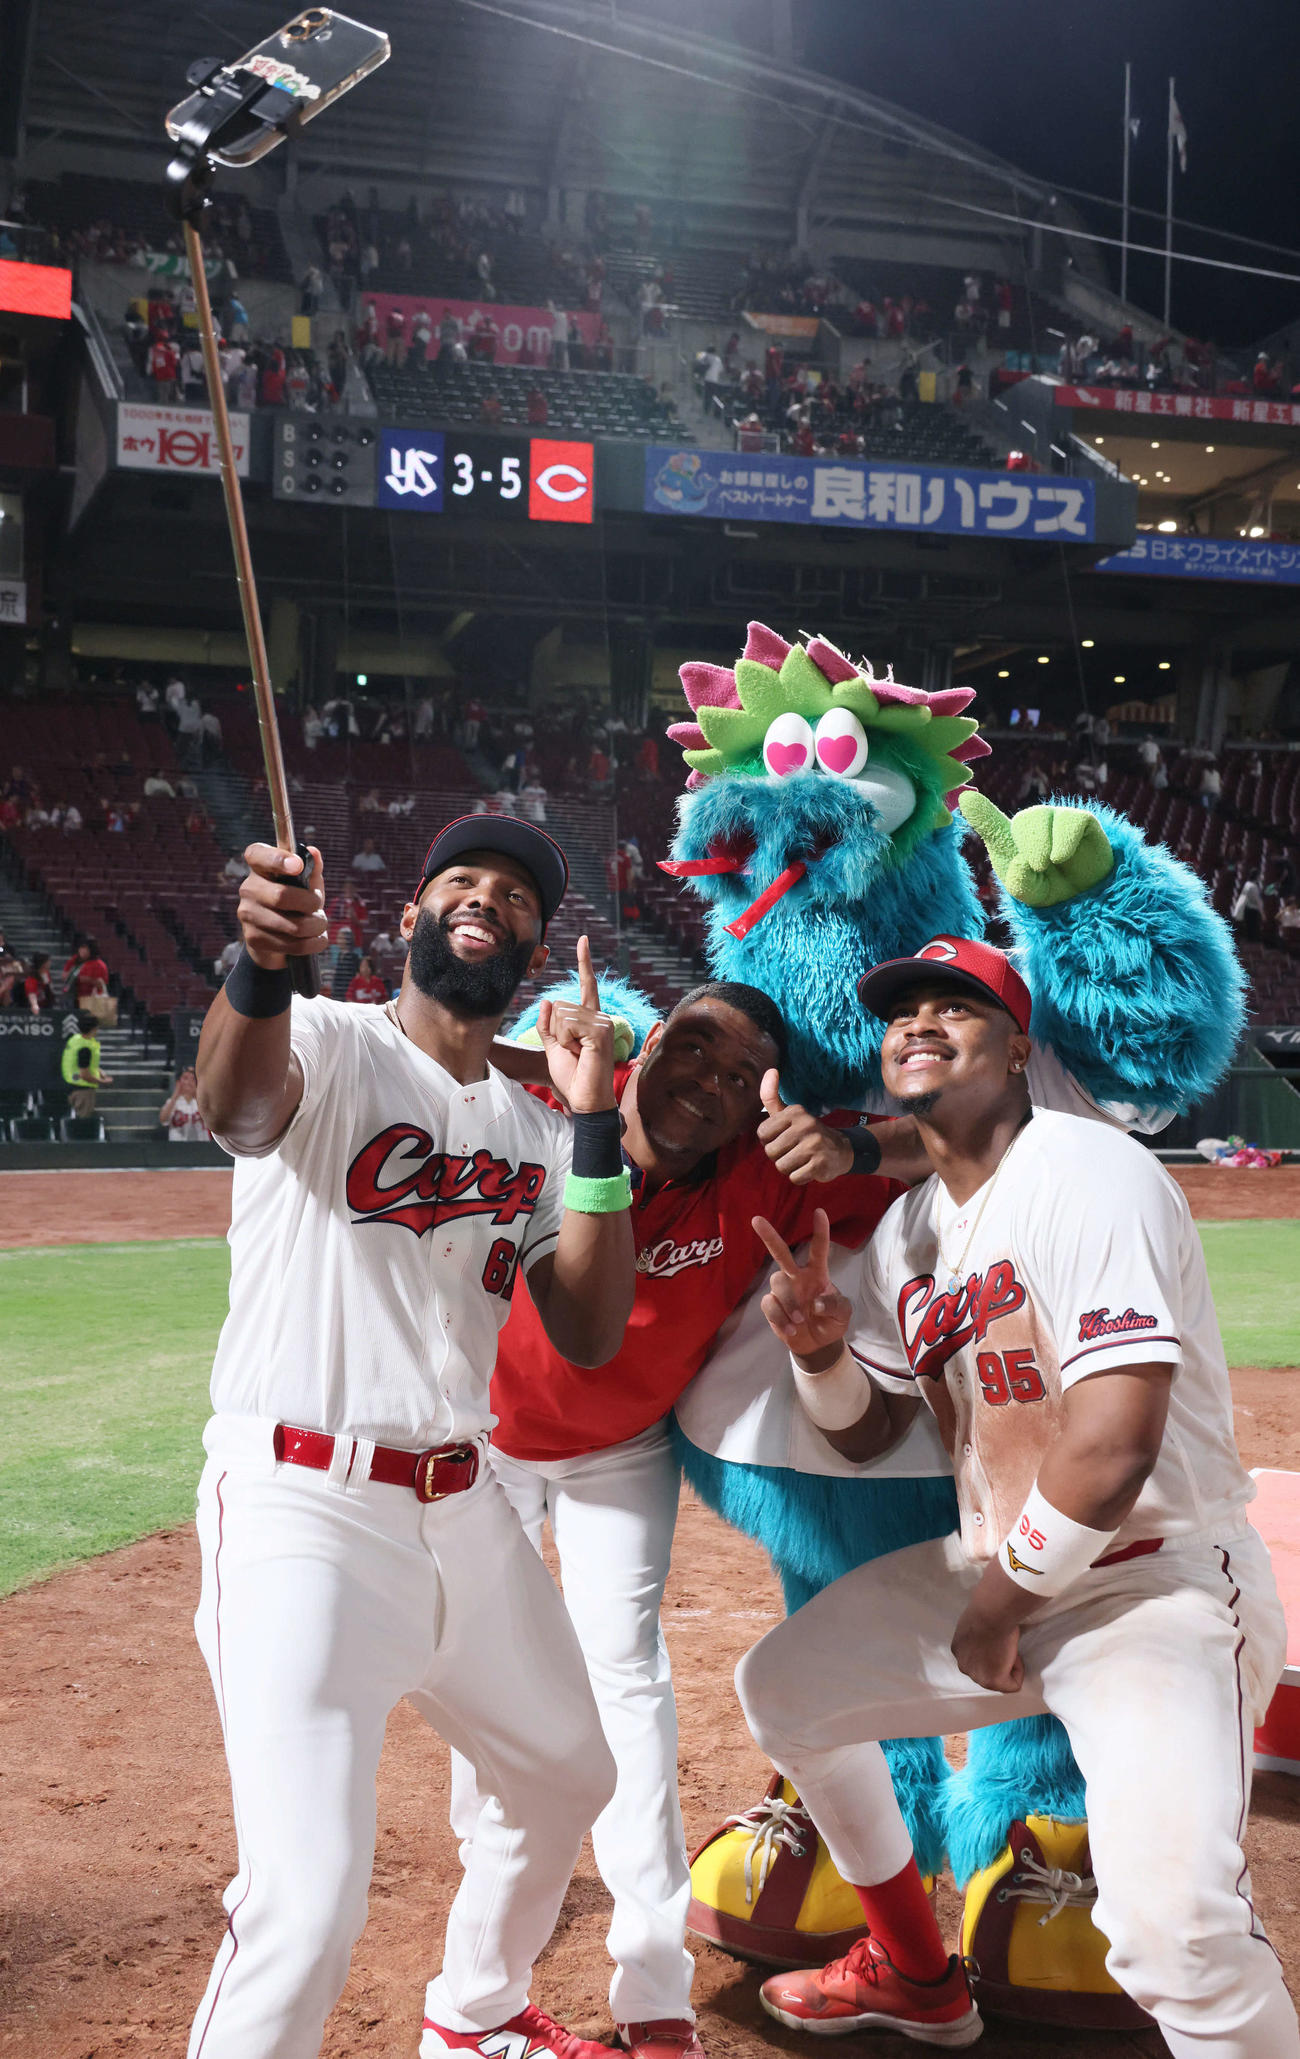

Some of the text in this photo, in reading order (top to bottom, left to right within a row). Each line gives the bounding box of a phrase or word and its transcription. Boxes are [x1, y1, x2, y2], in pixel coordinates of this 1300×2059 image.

[283, 424, 295, 442] B
[283, 450, 295, 468] S
[811, 466, 1087, 537] 良和ハウス
[345, 1122, 546, 1239] Carp
[647, 1237, 724, 1277] Carp
[897, 1260, 1026, 1382] Carp
[1078, 1307, 1158, 1342] Hiroshima
[976, 1348, 1047, 1406] 95
[1019, 1513, 1047, 1551] 95
